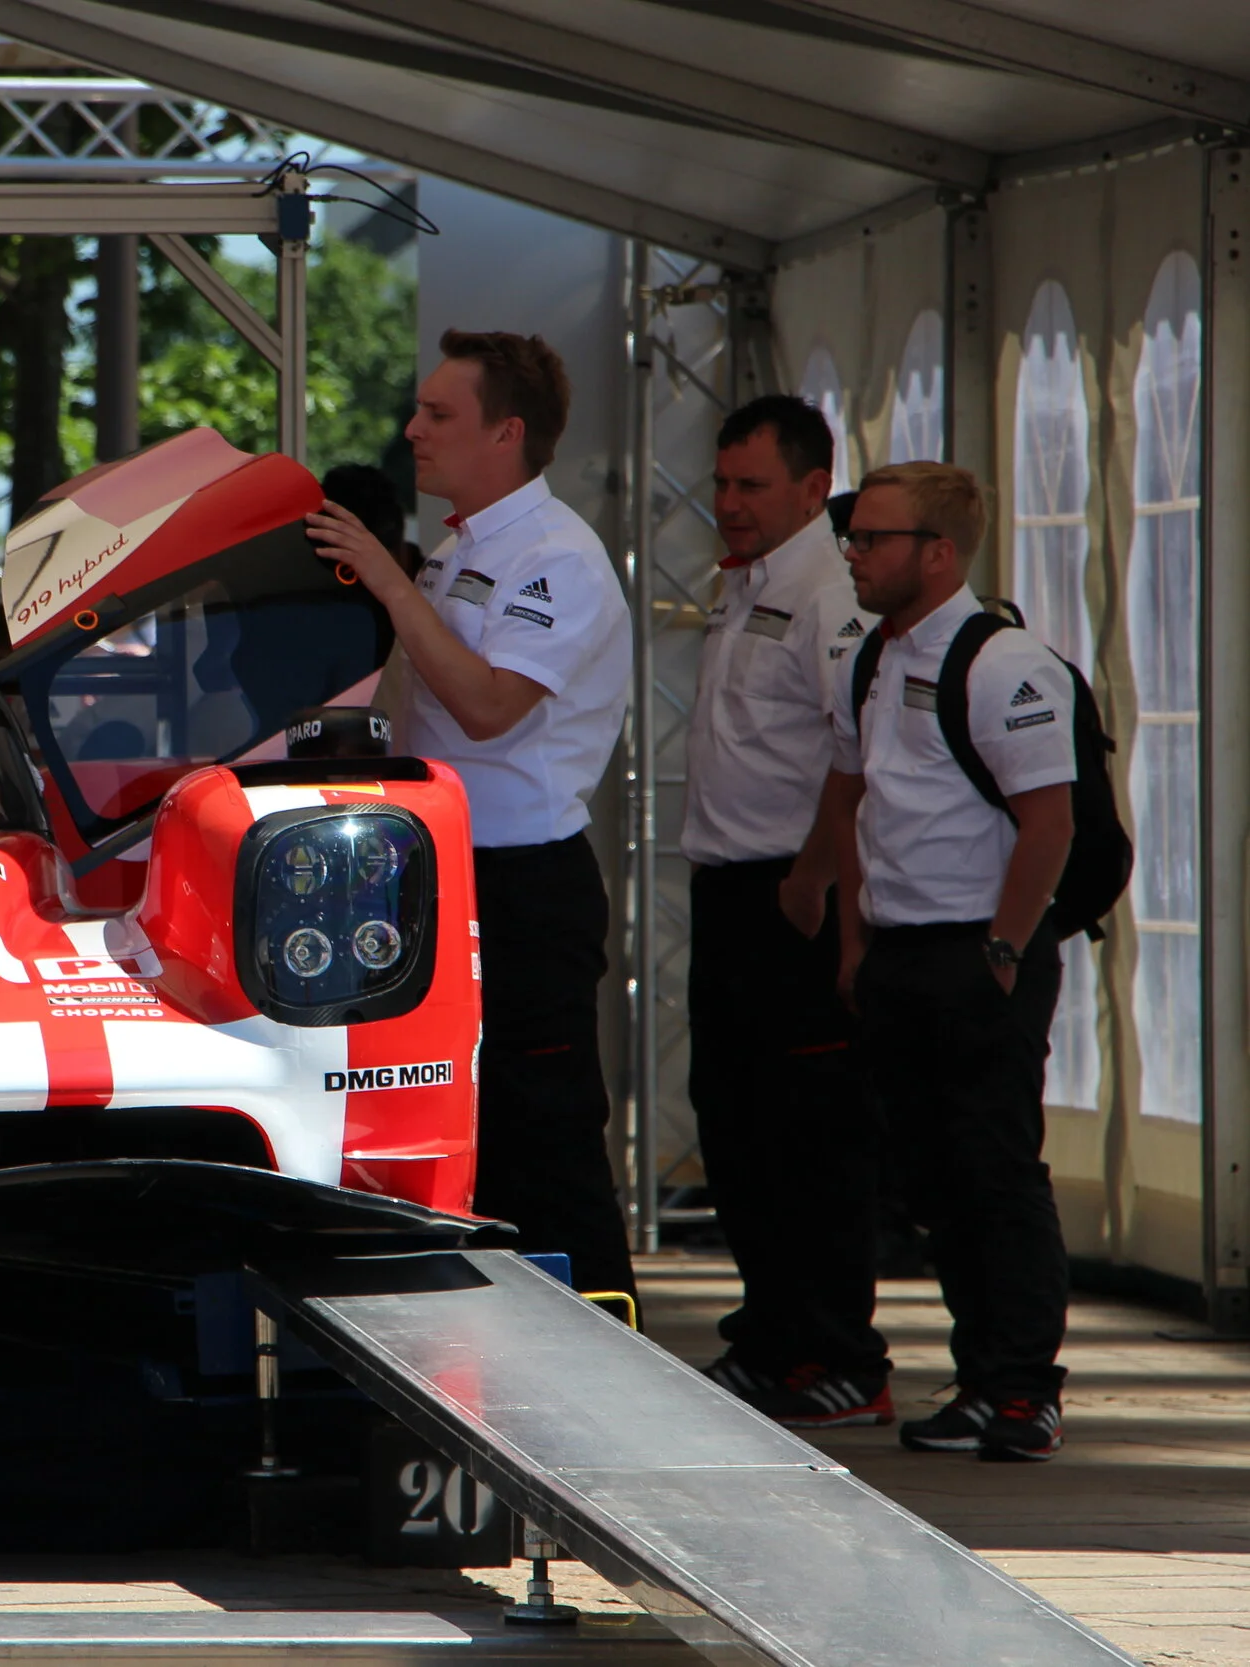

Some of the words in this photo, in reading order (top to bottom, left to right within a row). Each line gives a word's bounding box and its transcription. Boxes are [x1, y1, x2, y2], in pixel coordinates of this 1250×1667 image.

[17, 590, 53, 625] 919
[59, 533, 129, 595] hybrid
[519, 587, 552, 602] adidas
[42, 982, 126, 994] Mobil
[51, 1009, 163, 1017] CHOPARD
[324, 1068, 394, 1092] DMG
[399, 1063, 452, 1087] MORI
[399, 1461, 494, 1535] 20
